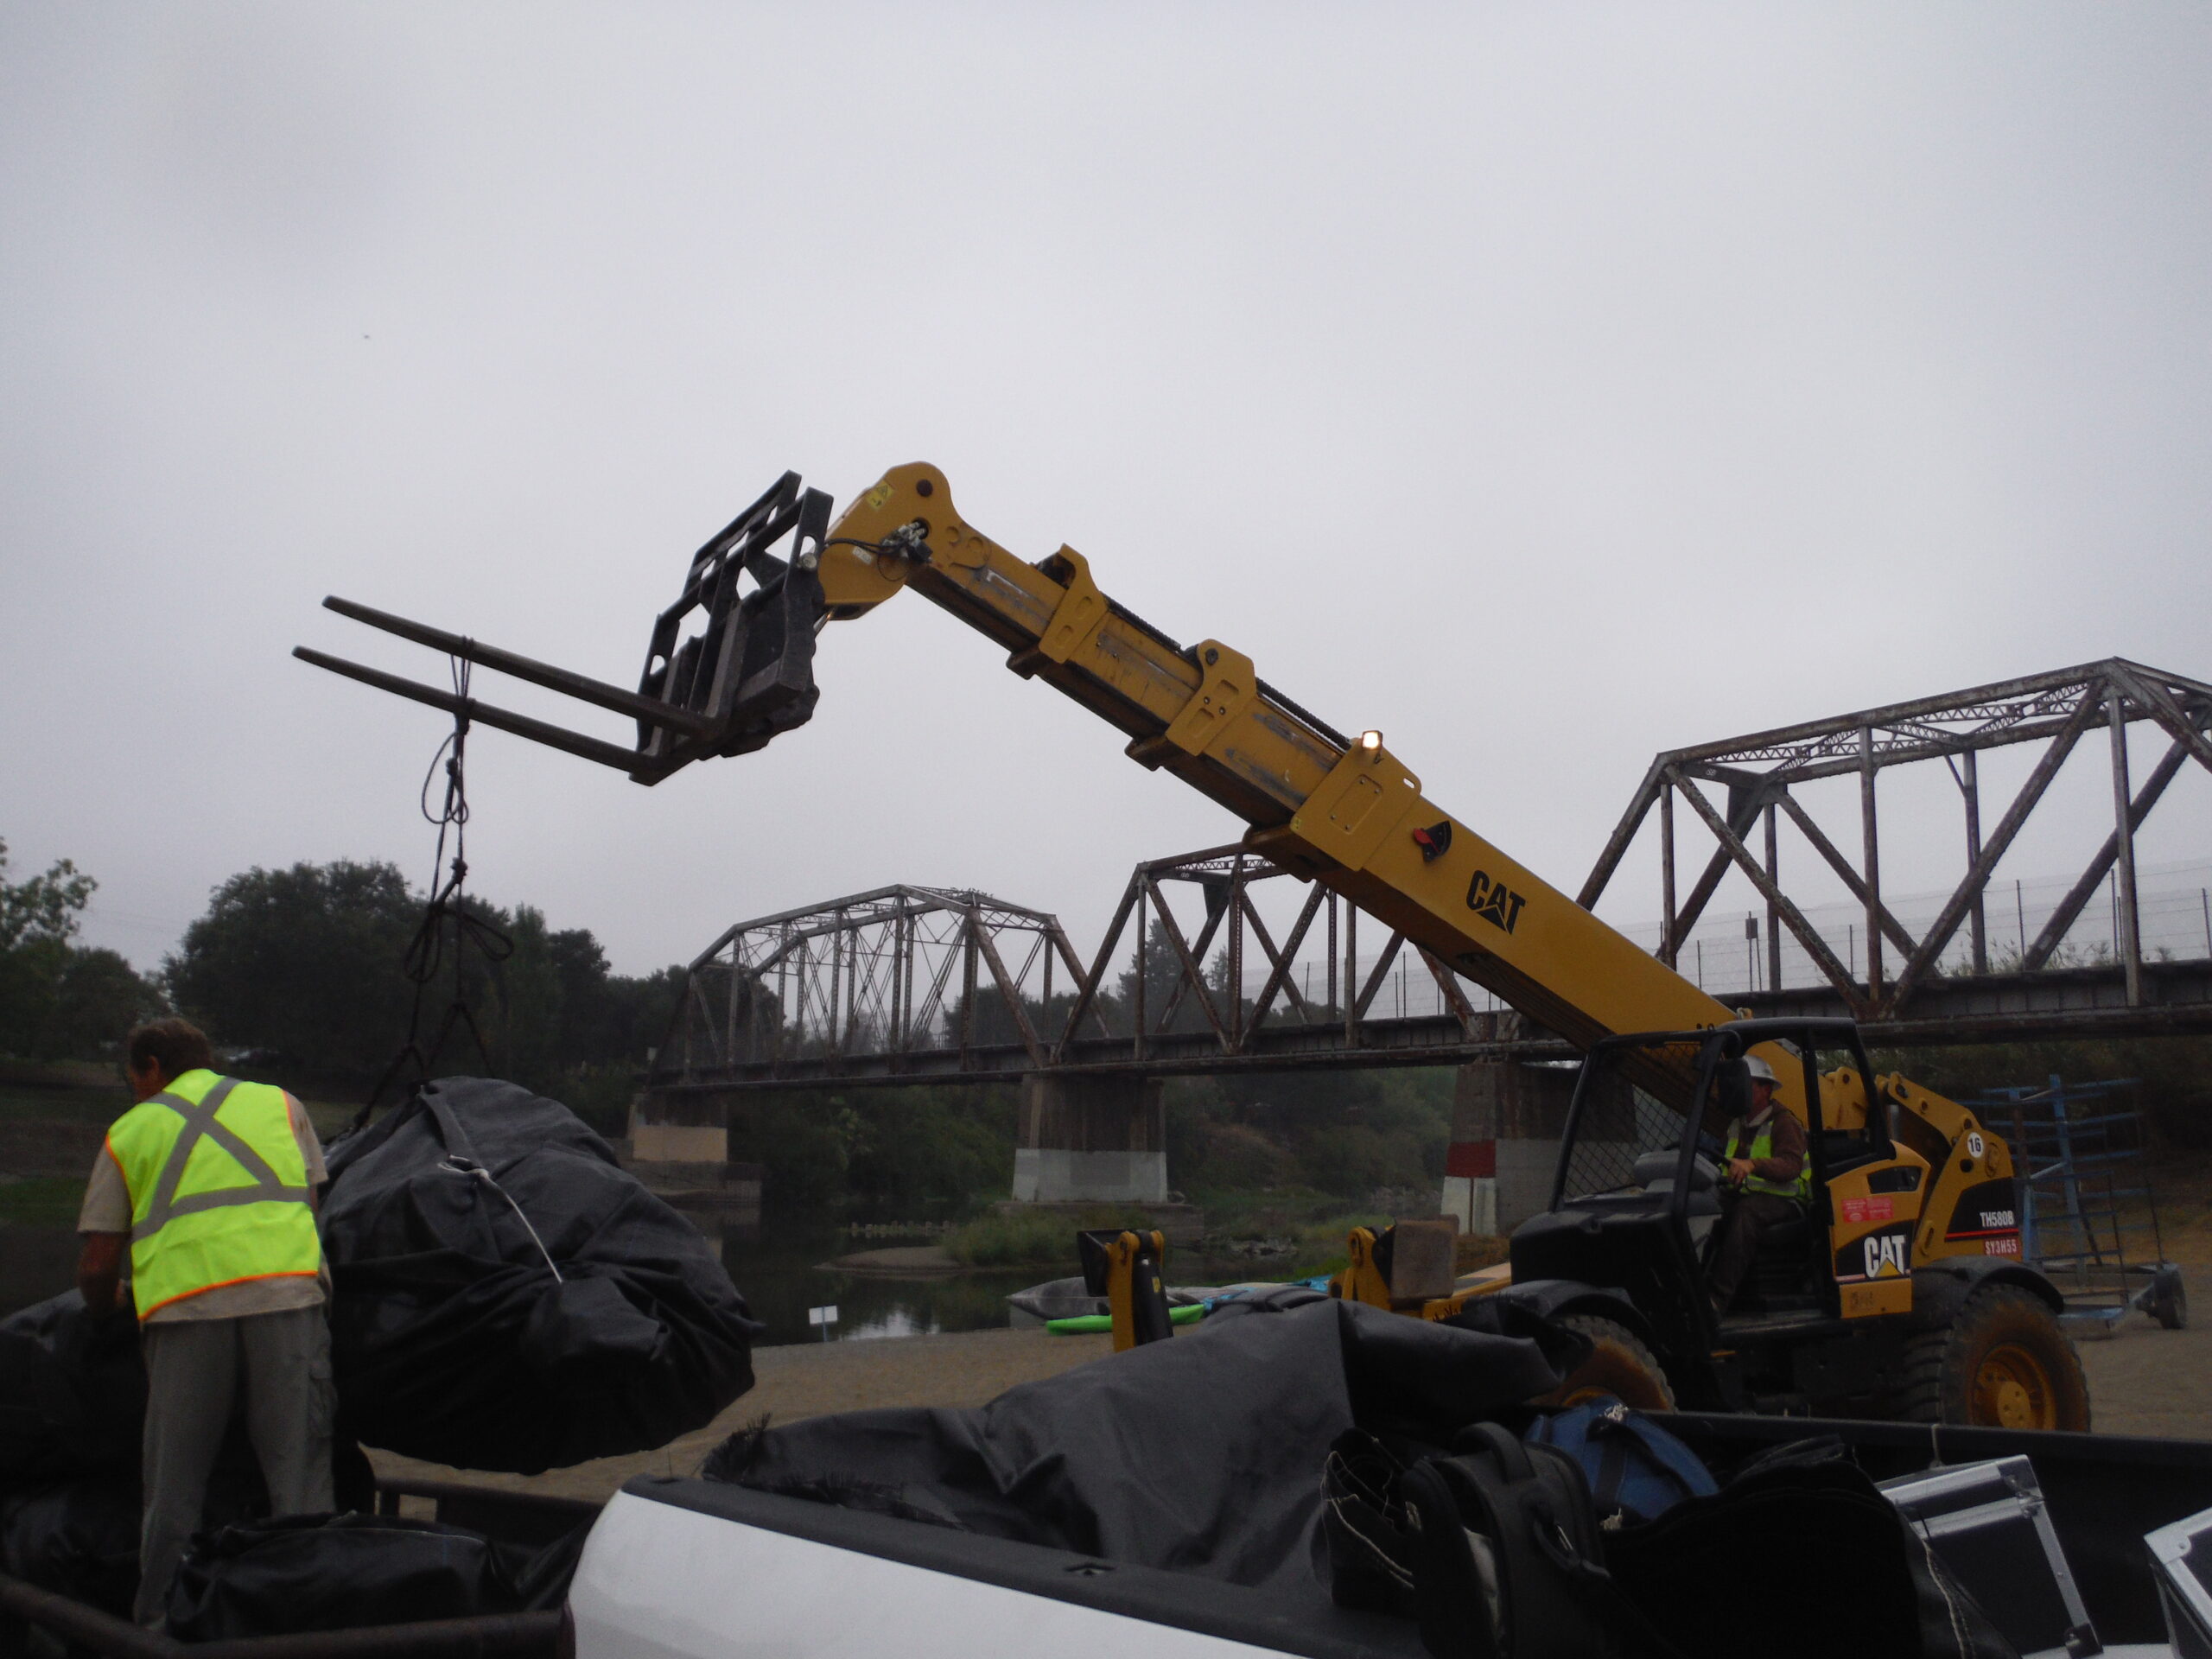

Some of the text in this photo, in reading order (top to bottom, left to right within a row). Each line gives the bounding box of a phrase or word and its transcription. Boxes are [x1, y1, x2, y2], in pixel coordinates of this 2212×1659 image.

[1466, 869, 1527, 935] CAT
[1968, 1137, 1982, 1154] 16
[1980, 1211, 2015, 1228] TH580B
[1985, 1239, 2018, 1255] SY3H55
[1864, 1234, 1906, 1279] CAT
